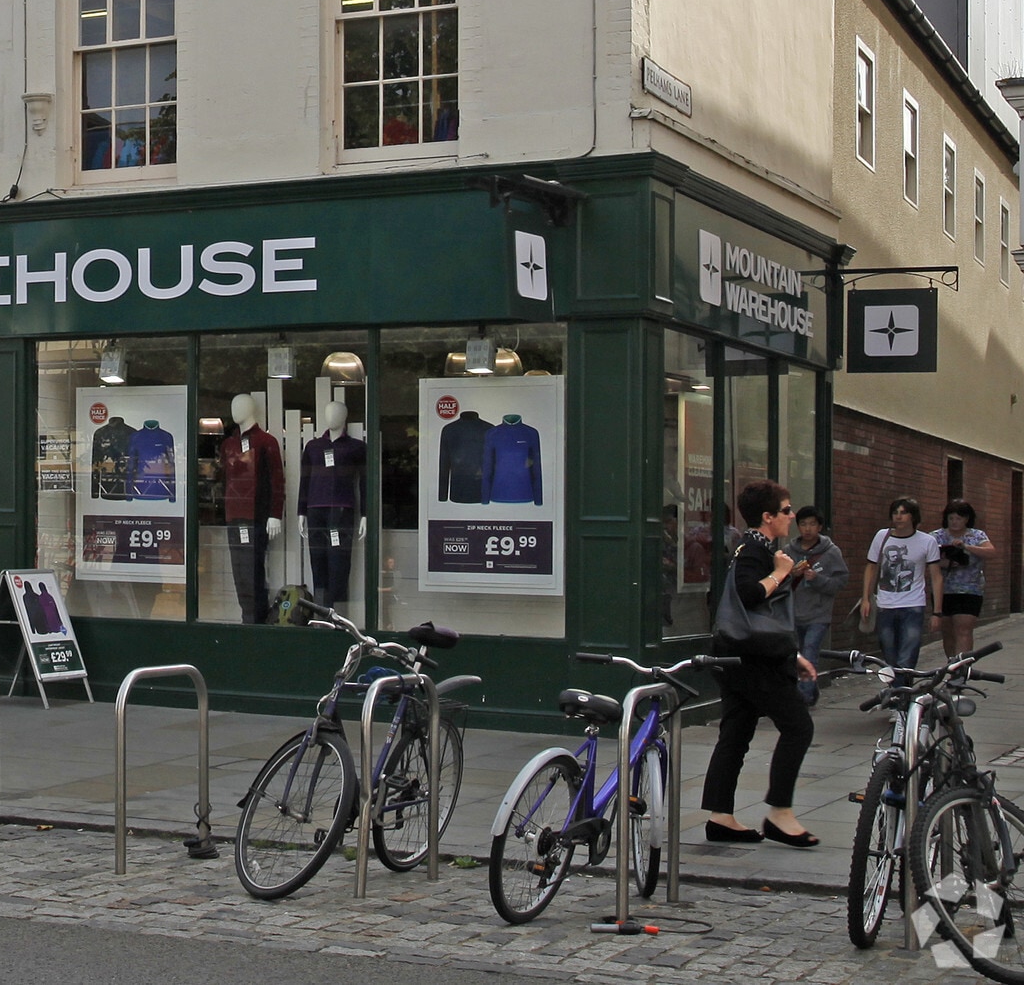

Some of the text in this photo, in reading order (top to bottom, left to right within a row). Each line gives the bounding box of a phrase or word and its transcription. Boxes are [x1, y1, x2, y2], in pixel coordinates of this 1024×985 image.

[673, 85, 689, 107] LANE
[725, 242, 801, 298] MOUNTAIN
[725, 281, 814, 338] WAREHOUSE
[688, 487, 712, 512] SAL
[129, 529, 171, 548] £9.99
[445, 536, 537, 555] NOW £9.99
[50, 650, 73, 663] £29.99
